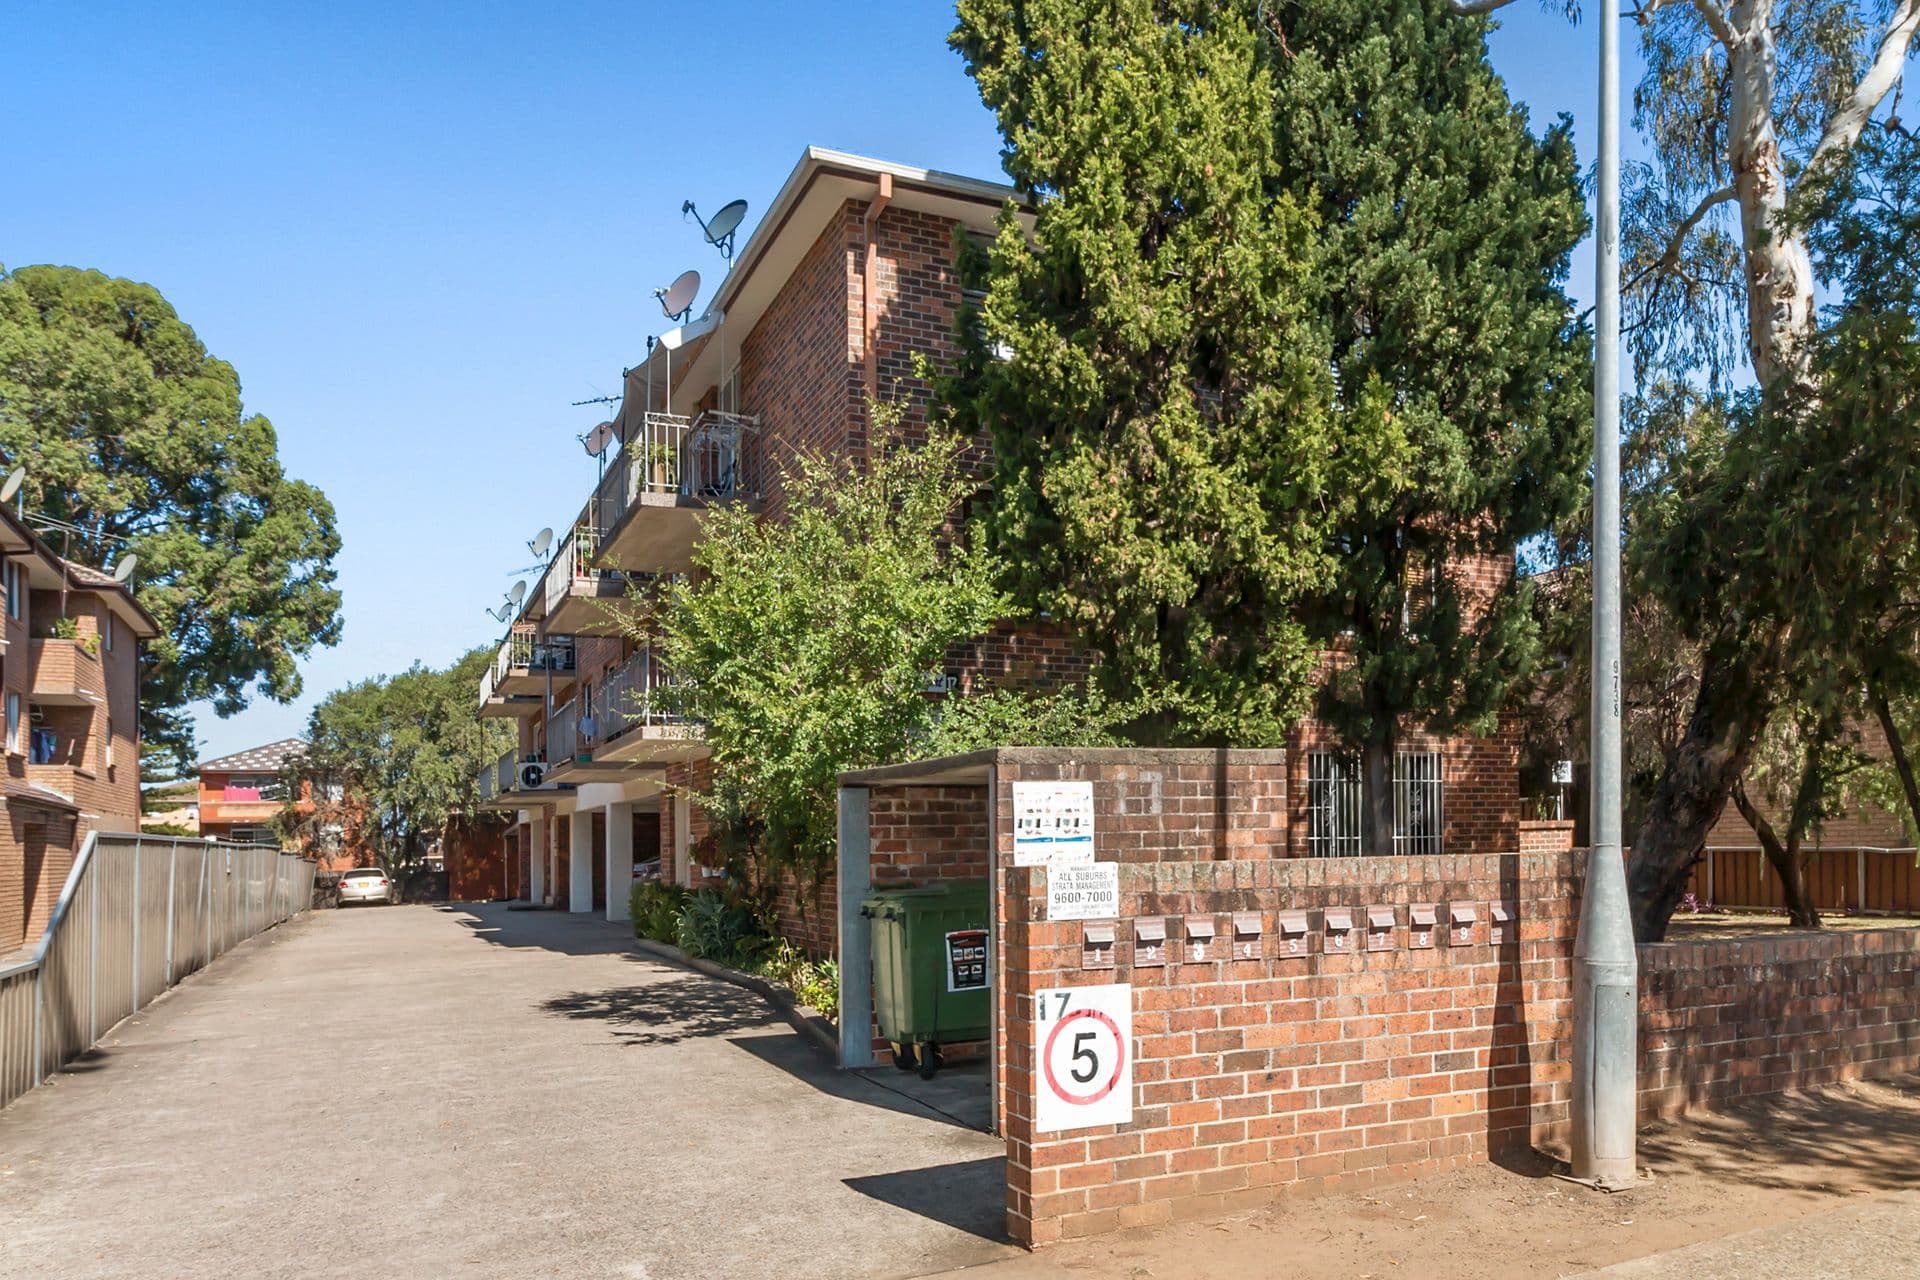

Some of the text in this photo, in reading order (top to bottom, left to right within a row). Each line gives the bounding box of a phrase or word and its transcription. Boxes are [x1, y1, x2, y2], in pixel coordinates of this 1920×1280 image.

[1059, 871, 1107, 881] ALL SUBURBS
[1052, 880, 1113, 891] STRATA MANAGEMENT
[1054, 891, 1112, 904] 9600-7000
[1376, 932, 1385, 945] 7
[1419, 933, 1427, 946] 8
[1460, 927, 1468, 940] 9
[1289, 939, 1298, 953] 5
[1335, 934, 1344, 947] 6
[1094, 948, 1101, 962] 1
[1146, 945, 1156, 959] 2
[1243, 943, 1252, 958] 4
[1039, 992, 1071, 1021] 17
[1071, 1032, 1098, 1083] 5
